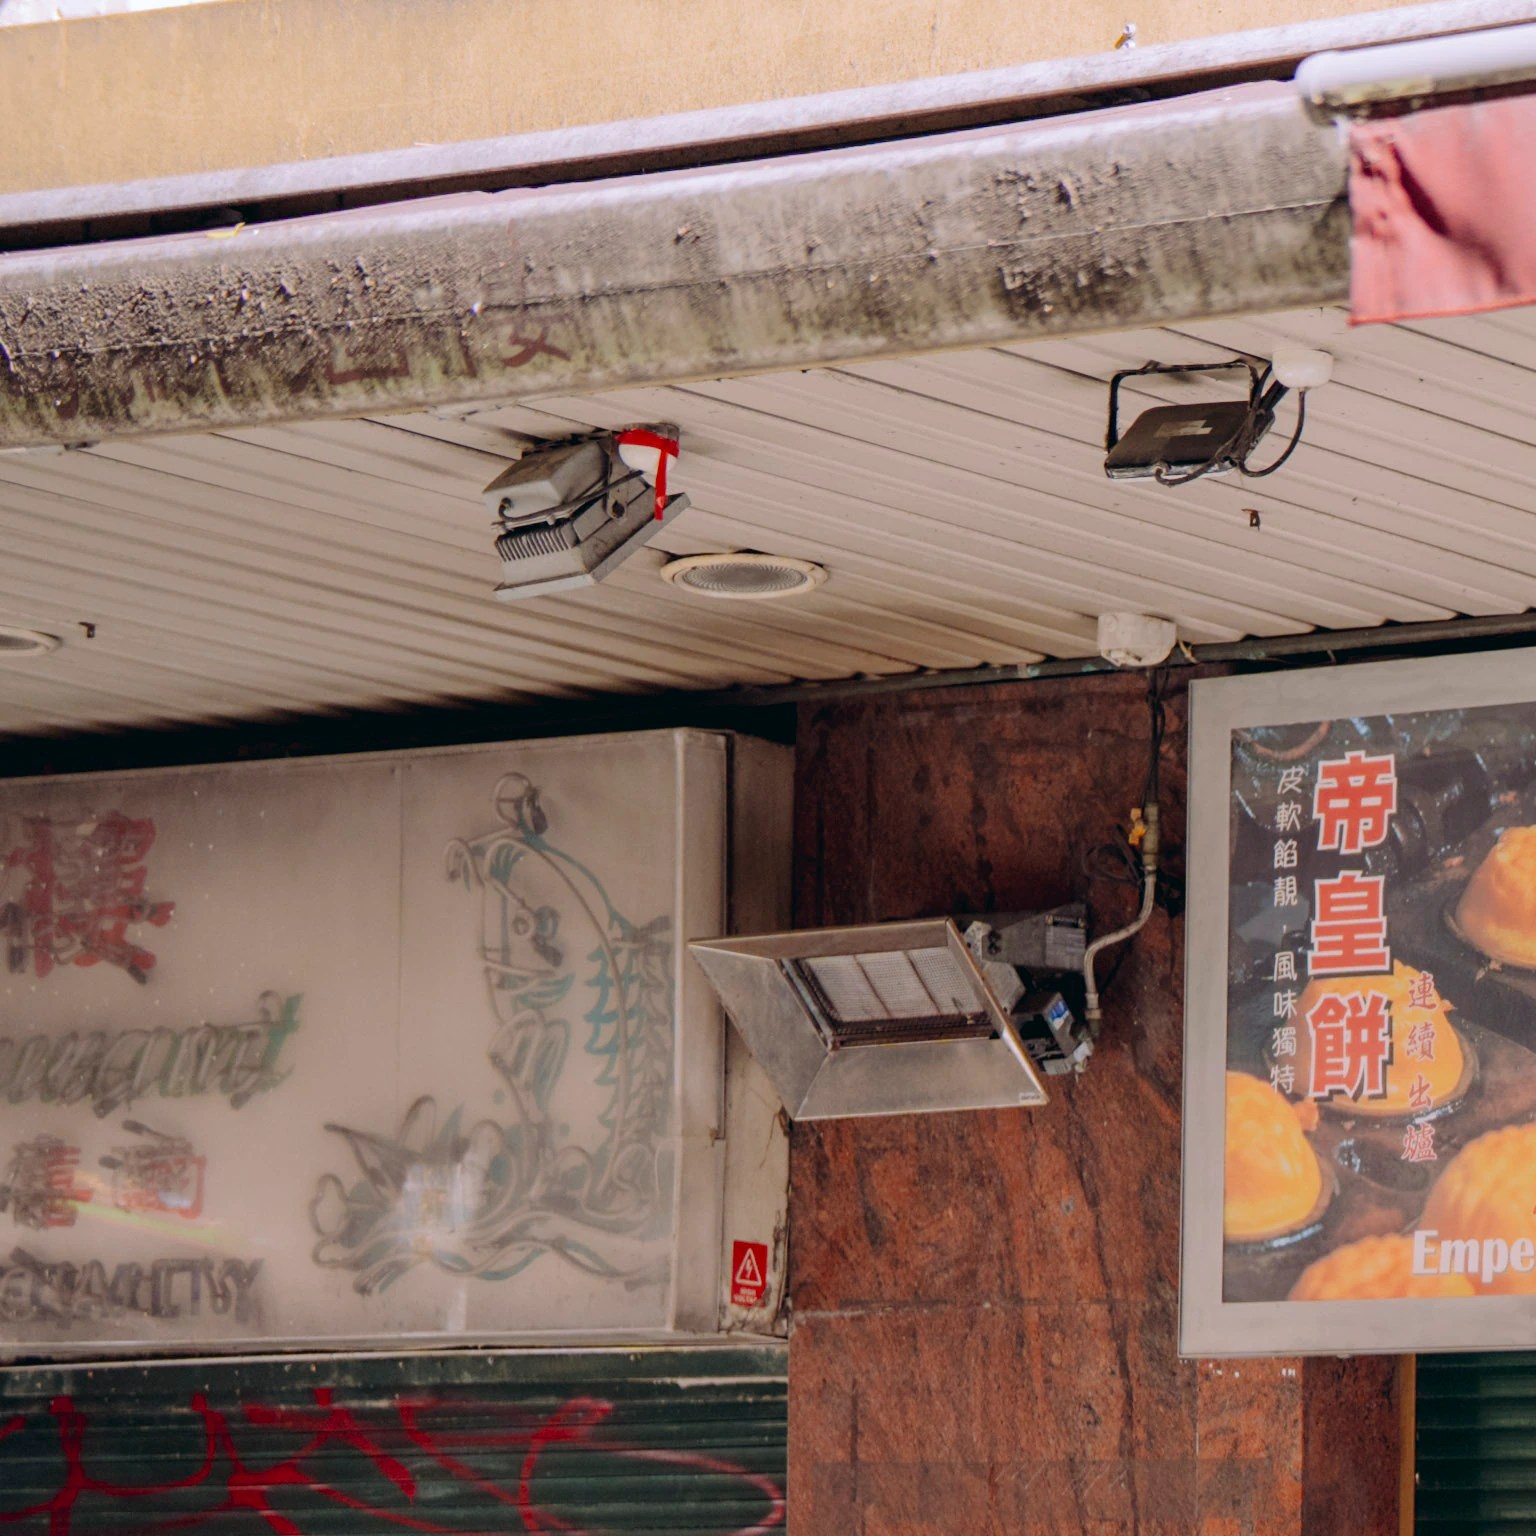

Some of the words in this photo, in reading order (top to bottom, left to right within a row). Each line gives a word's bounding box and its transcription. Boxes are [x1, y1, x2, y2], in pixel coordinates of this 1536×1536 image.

[1306, 750, 1397, 1100] 帝皇餅
[1402, 970, 1438, 1162] 連續出爐
